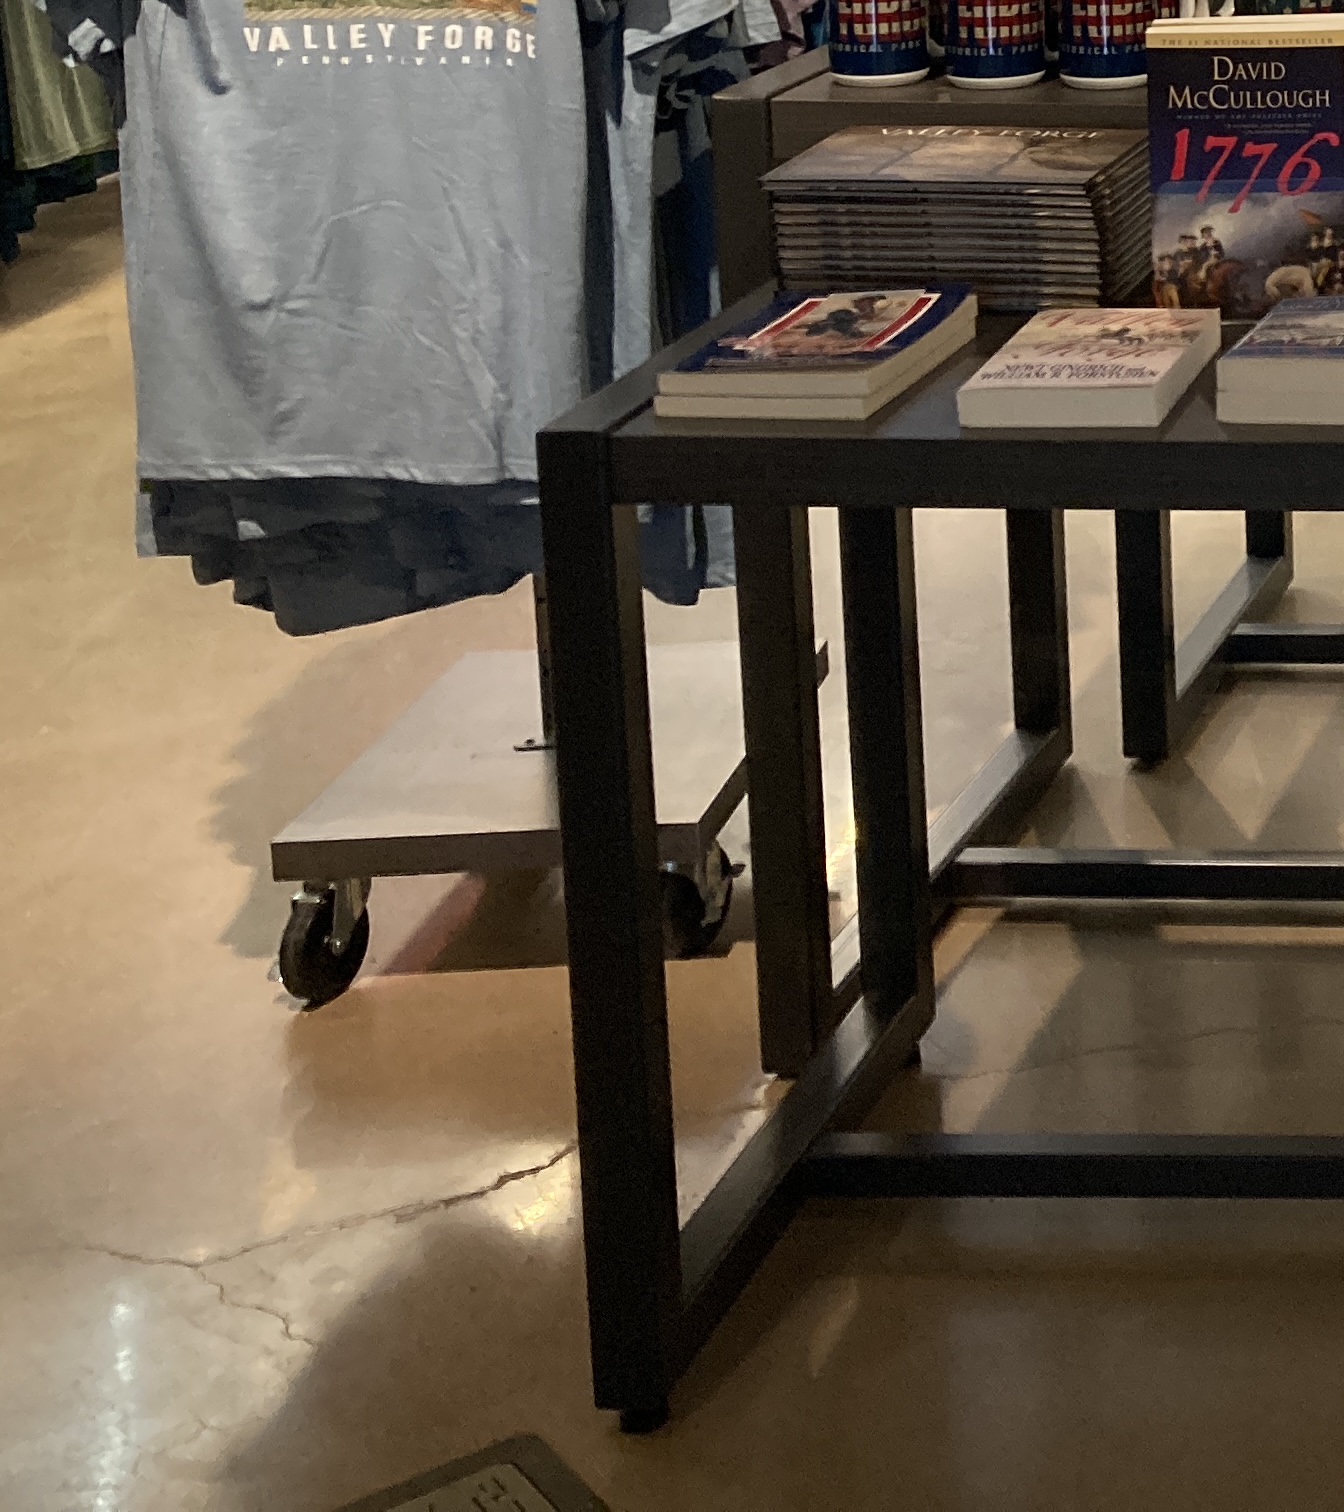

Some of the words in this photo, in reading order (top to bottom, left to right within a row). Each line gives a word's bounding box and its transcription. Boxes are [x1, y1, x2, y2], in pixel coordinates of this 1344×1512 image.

[243, 22, 395, 52] VALLEY
[416, 24, 536, 59] FORGE
[1204, 38, 1262, 46] NATIONAL
[1213, 56, 1286, 81] DAVID
[1170, 127, 1341, 214] 1776
